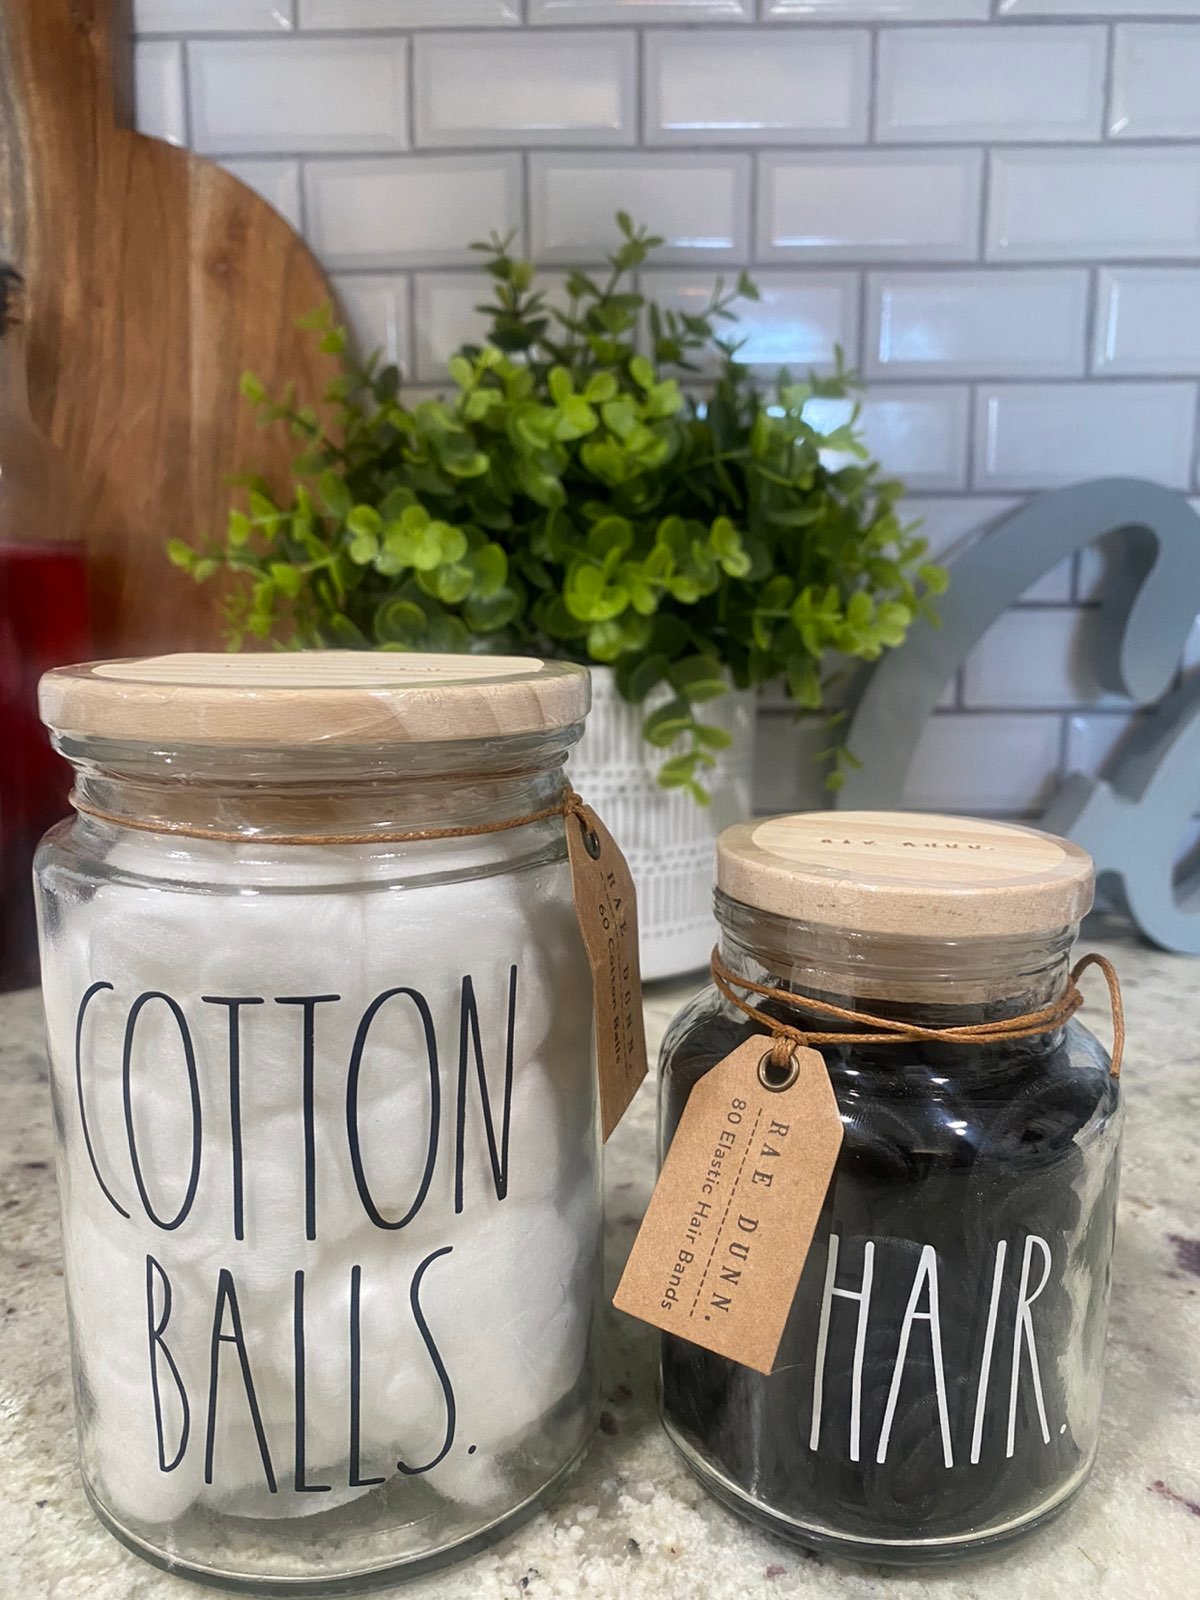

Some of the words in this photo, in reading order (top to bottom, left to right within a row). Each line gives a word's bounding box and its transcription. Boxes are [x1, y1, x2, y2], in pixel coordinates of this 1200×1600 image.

[599, 903, 610, 931] 60
[608, 937, 617, 1010] Cotton
[613, 1014, 622, 1065] Balls
[76, 964, 518, 1240] COTTON
[727, 1097, 747, 1125] 80
[701, 1130, 736, 1195] Elastic
[751, 1119, 791, 1188] RAE
[685, 1200, 712, 1246] Hair
[703, 1213, 759, 1322] DUNN.
[660, 1249, 694, 1311] Bands
[145, 1245, 477, 1494] BALLS.
[809, 1233, 1067, 1468] HAIR.
